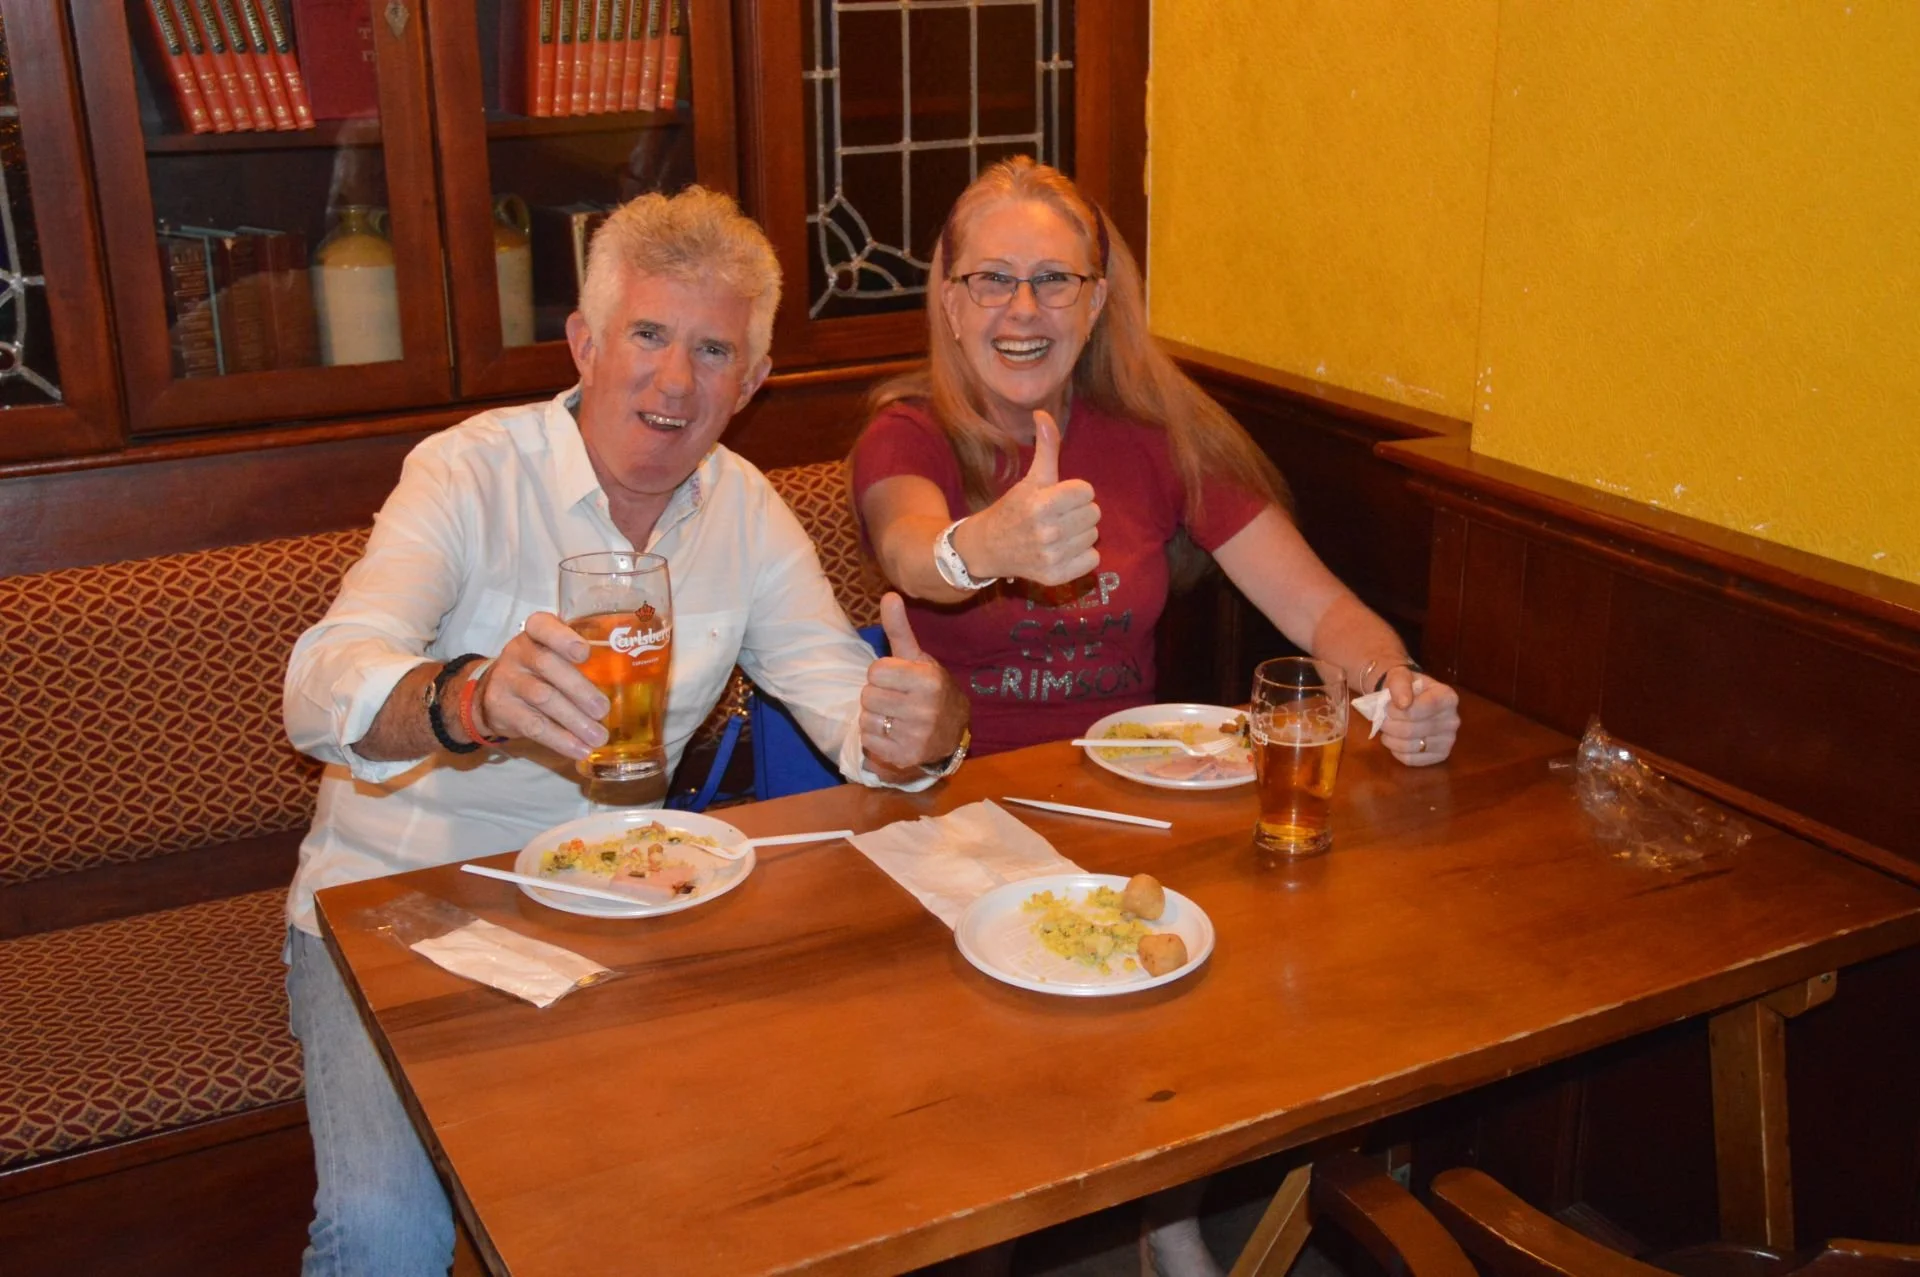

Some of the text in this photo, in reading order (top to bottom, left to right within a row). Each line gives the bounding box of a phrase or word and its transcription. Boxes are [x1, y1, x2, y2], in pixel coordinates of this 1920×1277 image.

[1026, 571, 1120, 611] EP
[609, 622, 672, 654] Carlsberg
[970, 657, 1142, 701] CRIMSON
